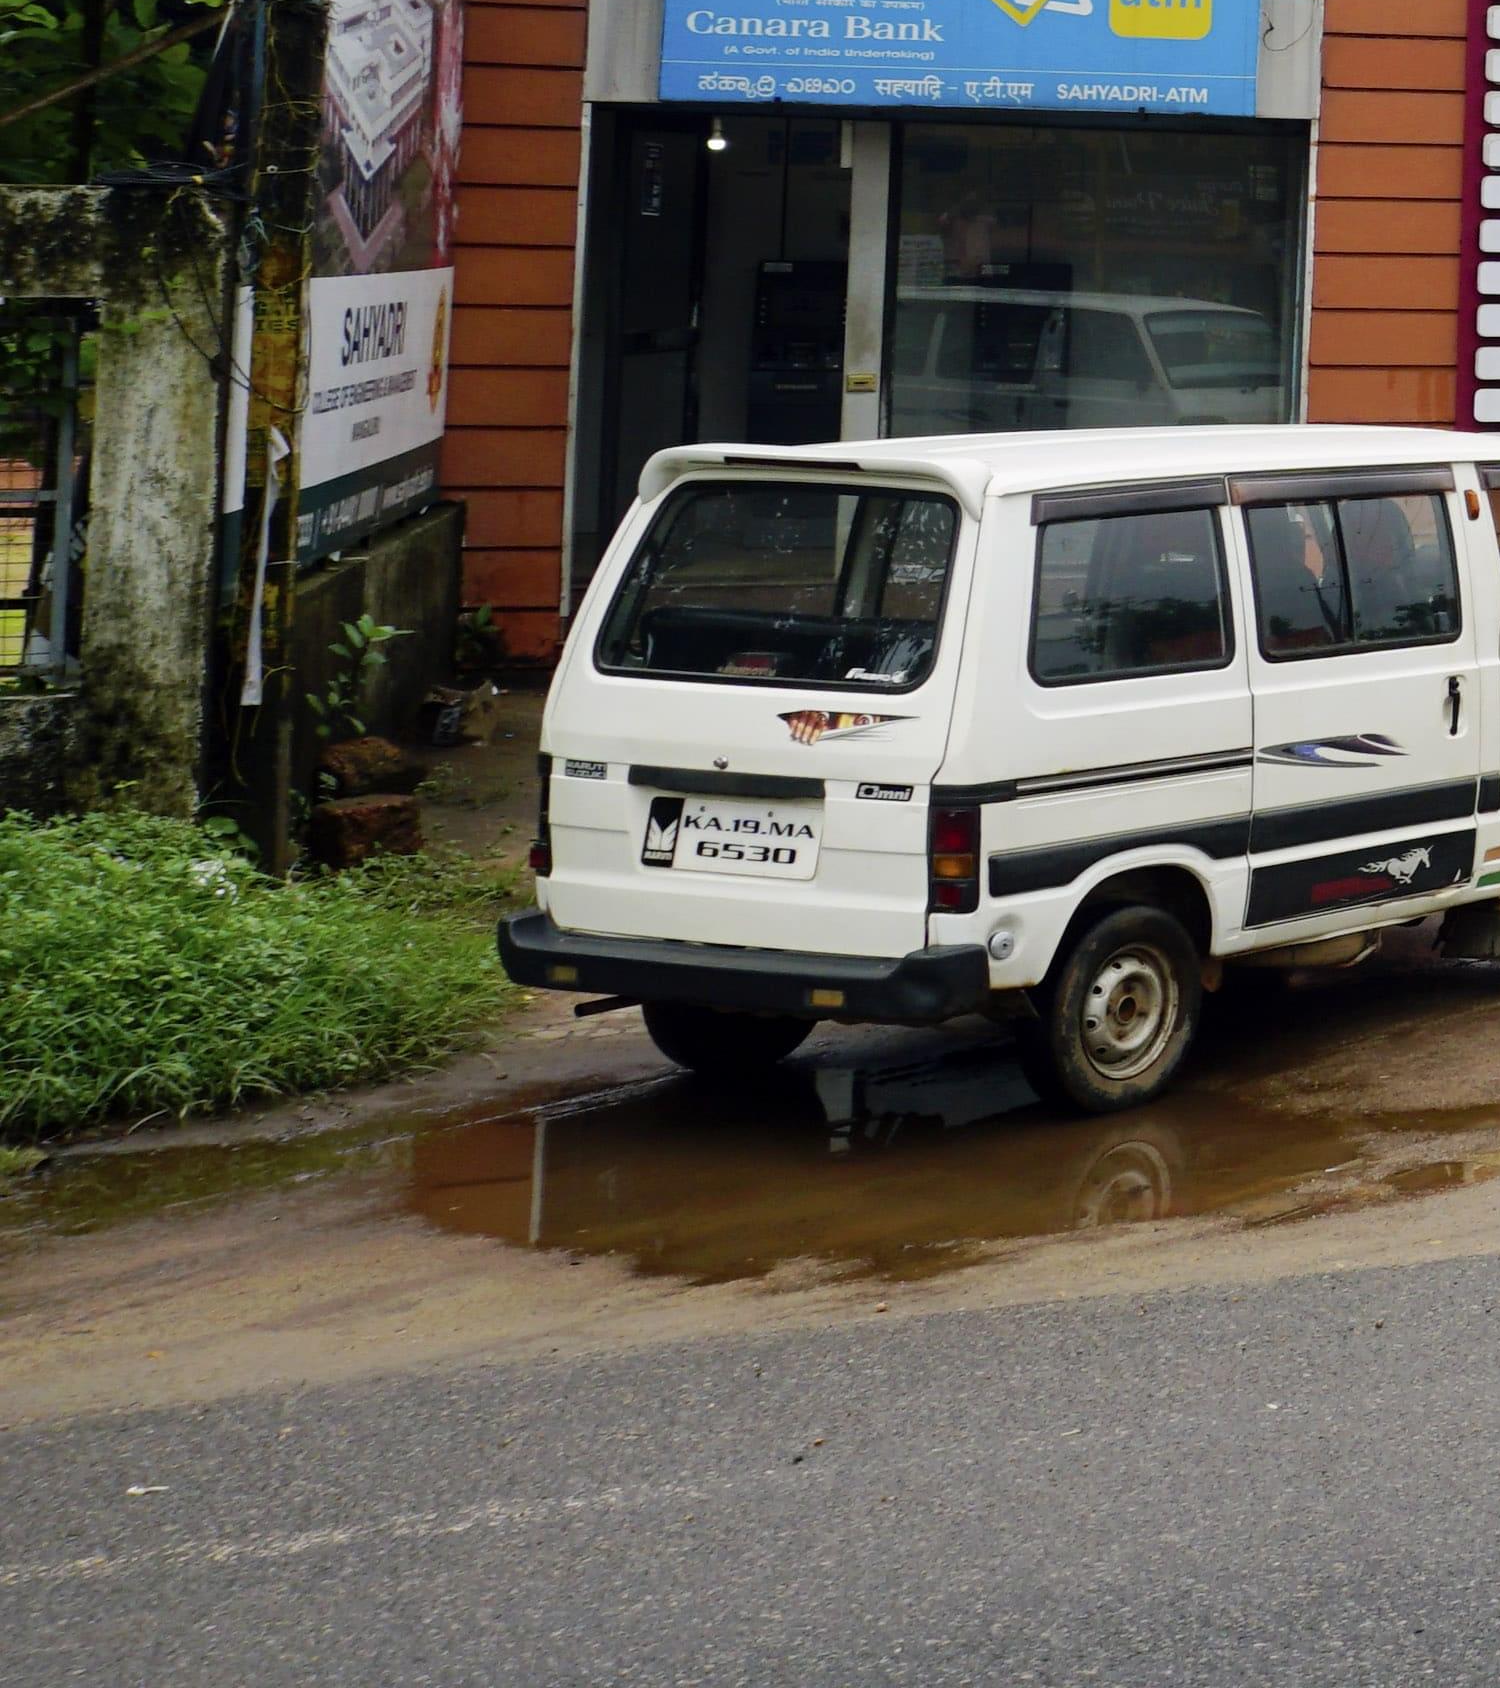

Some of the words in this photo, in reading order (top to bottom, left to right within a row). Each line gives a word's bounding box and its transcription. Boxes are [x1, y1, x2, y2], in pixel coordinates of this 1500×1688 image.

[686, 10, 830, 38] Canara
[844, 15, 945, 42] Bank
[786, 46, 800, 56] of
[803, 46, 840, 57] India
[1056, 84, 1208, 105] SAHYADRI-ATM
[341, 301, 408, 367] SAHYADRI
[858, 784, 912, 801] Omni
[683, 815, 816, 839] KA.19.MA
[696, 841, 797, 865] 6530
